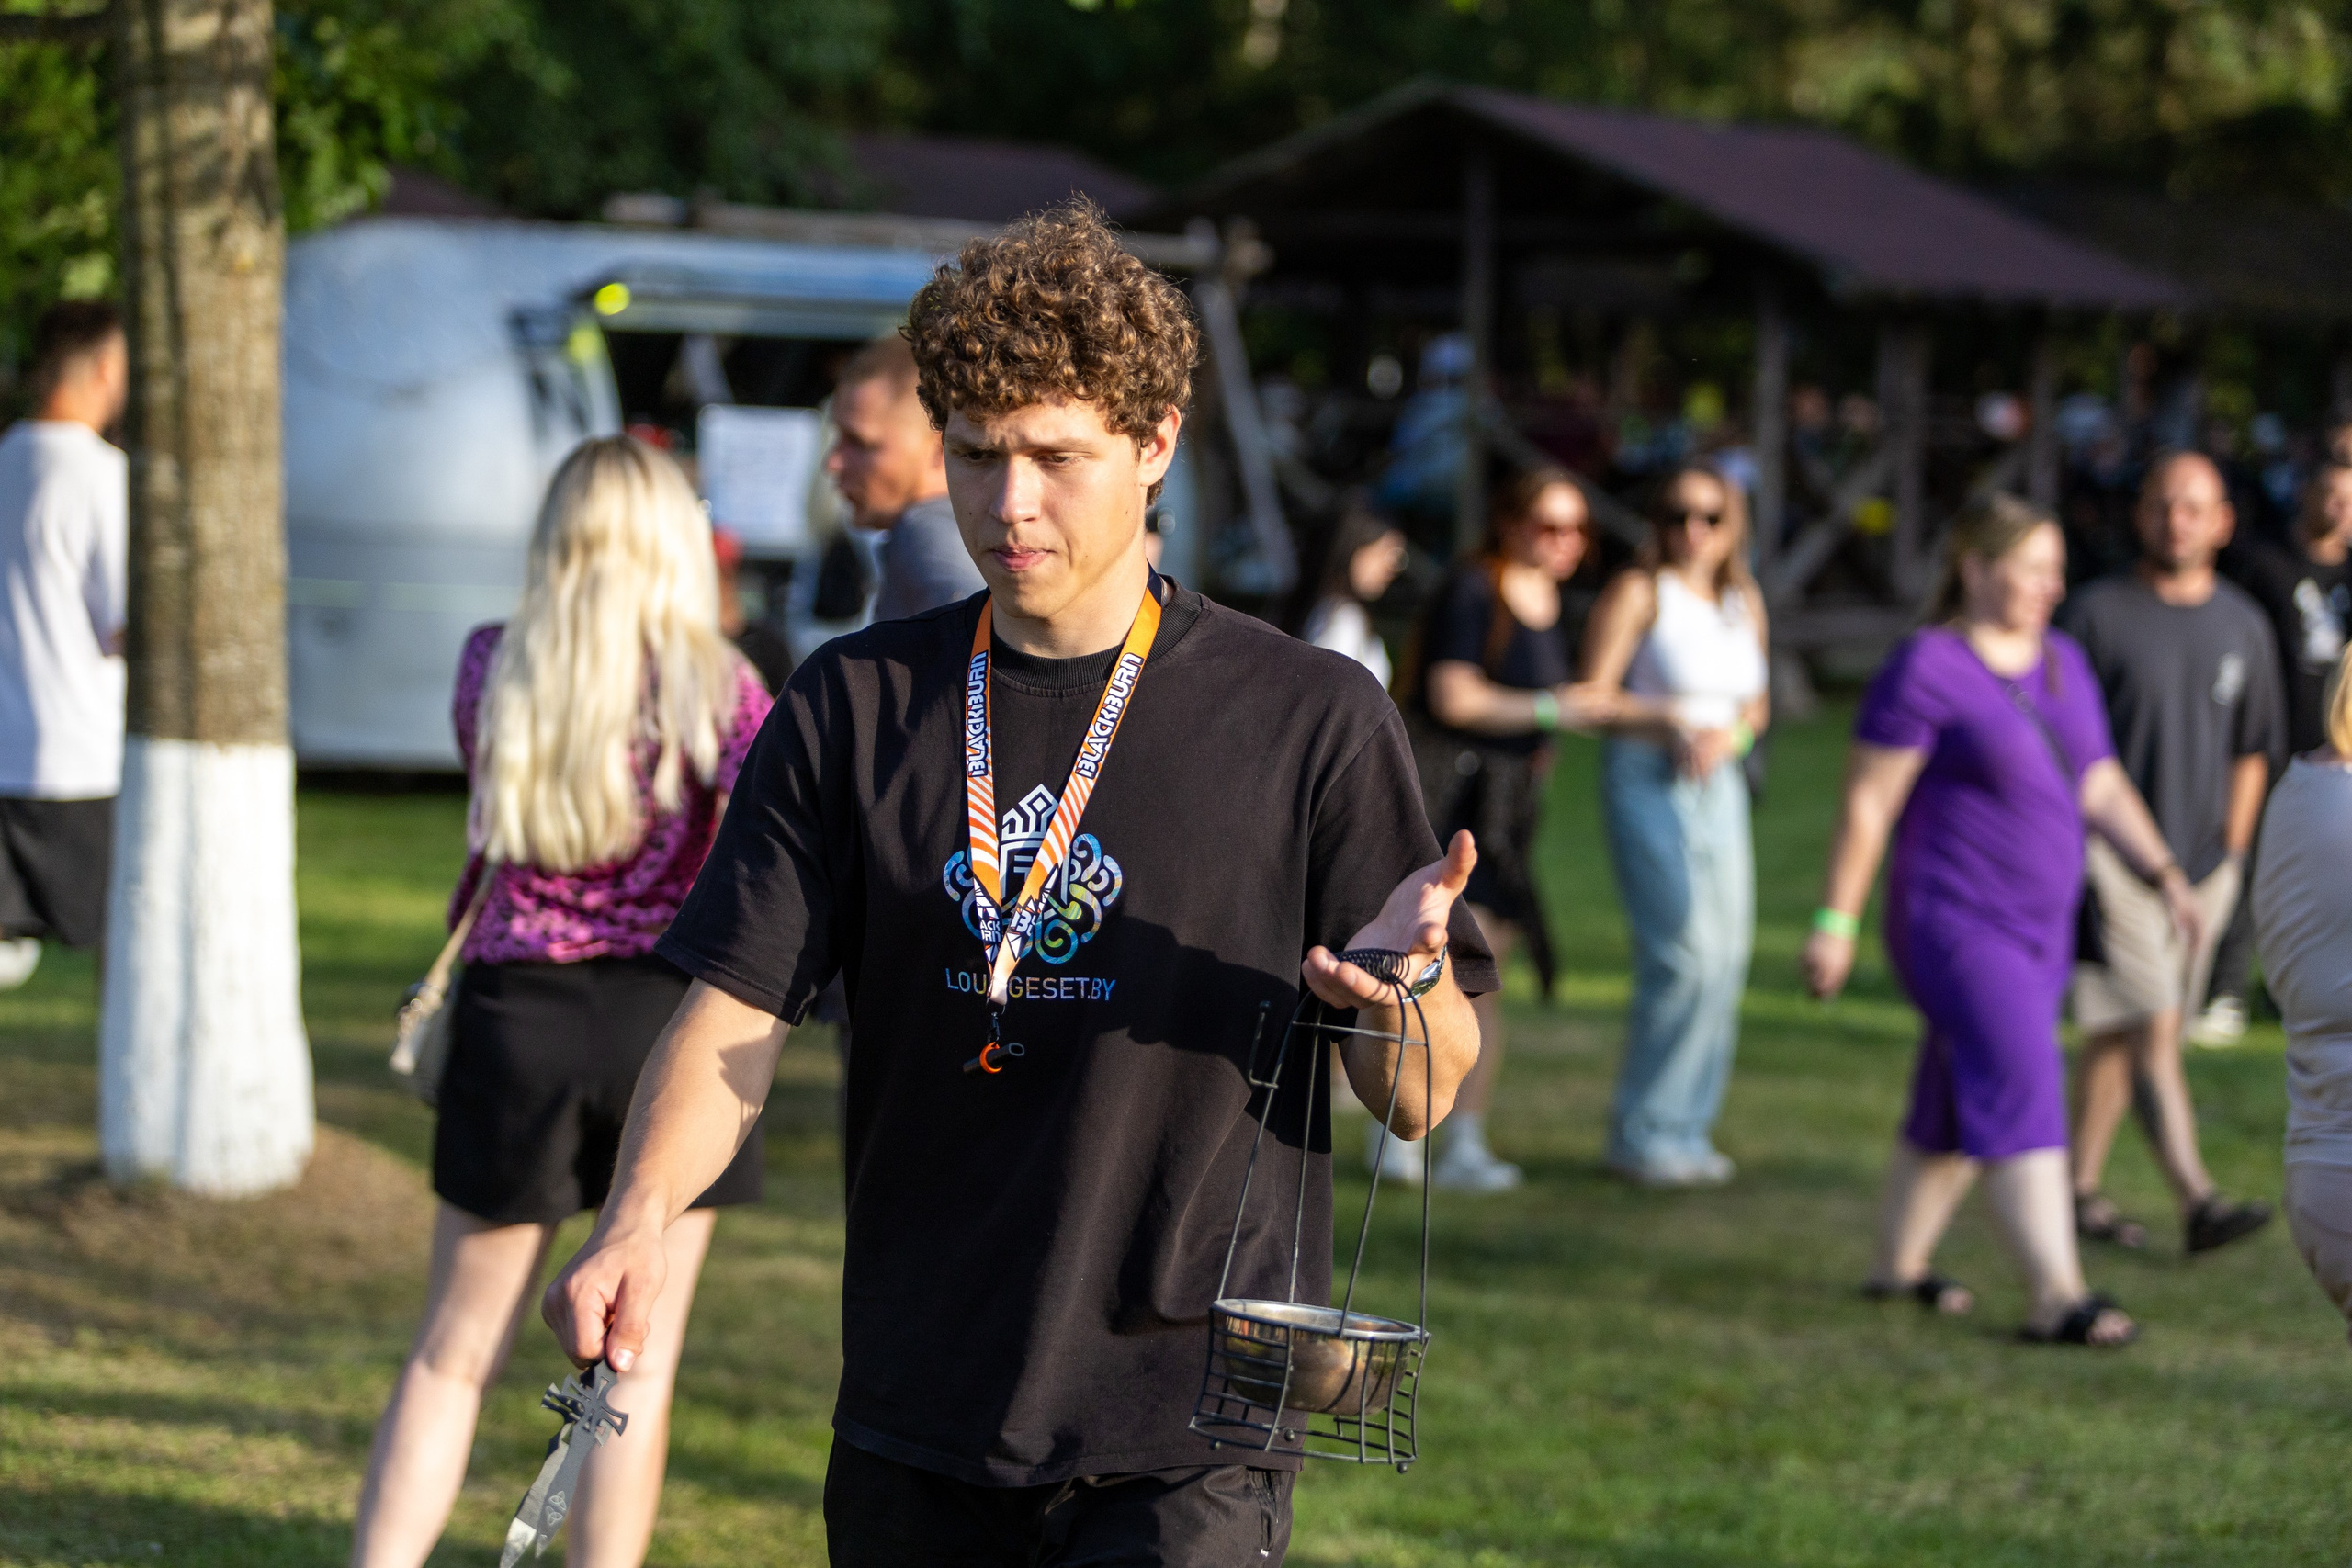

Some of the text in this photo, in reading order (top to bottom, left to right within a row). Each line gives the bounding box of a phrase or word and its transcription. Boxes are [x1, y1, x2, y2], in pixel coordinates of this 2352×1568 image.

[967, 650, 989, 777] BLACKBURN
[1075, 653, 1145, 779] BLACKBURN
[979, 919, 1001, 931] ACK
[945, 968, 1116, 1001] LOUGESET.BY
